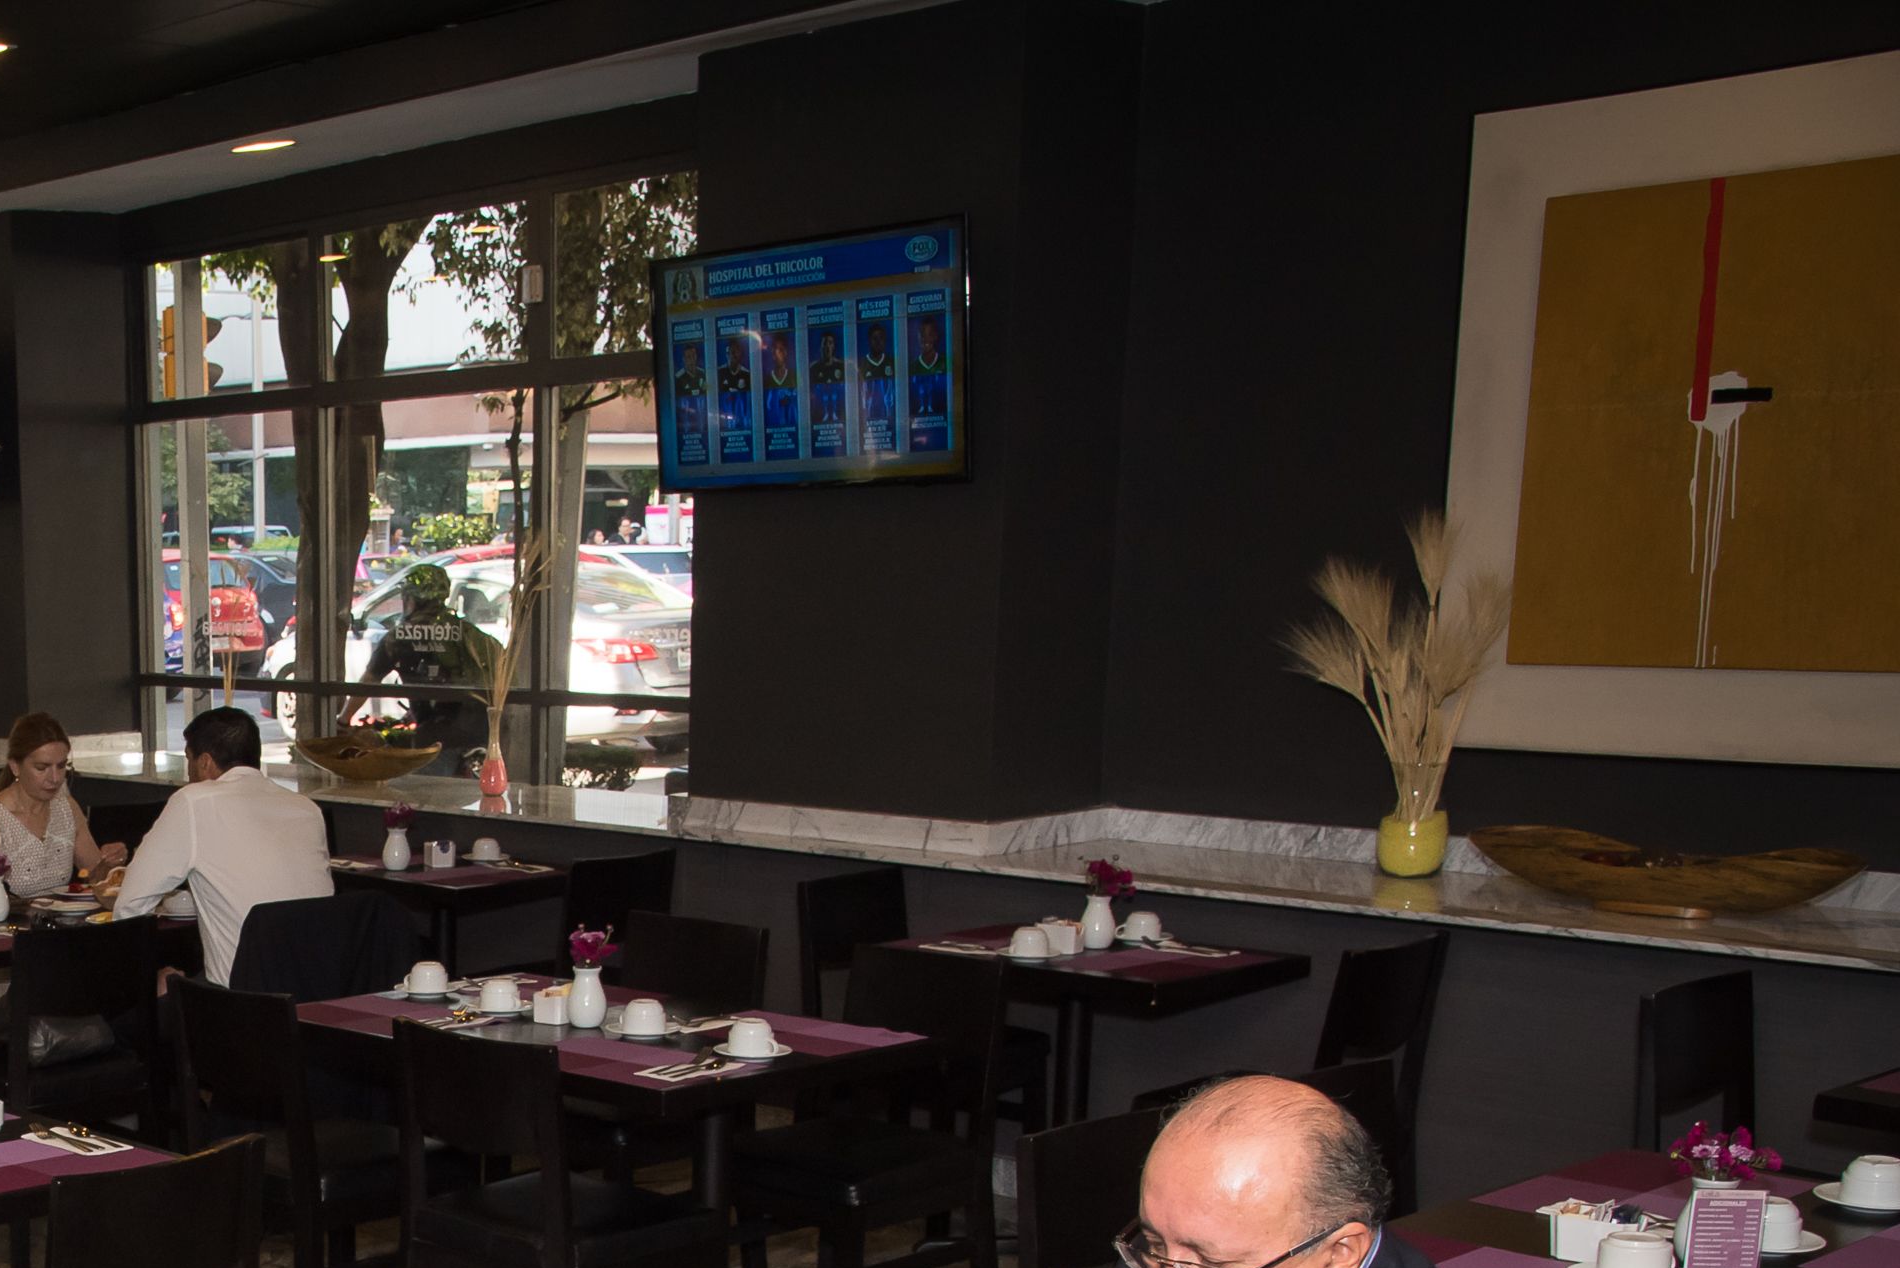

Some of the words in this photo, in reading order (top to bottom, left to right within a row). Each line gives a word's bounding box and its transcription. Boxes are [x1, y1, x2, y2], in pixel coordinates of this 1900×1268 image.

[708, 266, 754, 285] HOSPITAL
[755, 264, 774, 278] DEL
[774, 256, 824, 275] TRICOLOR
